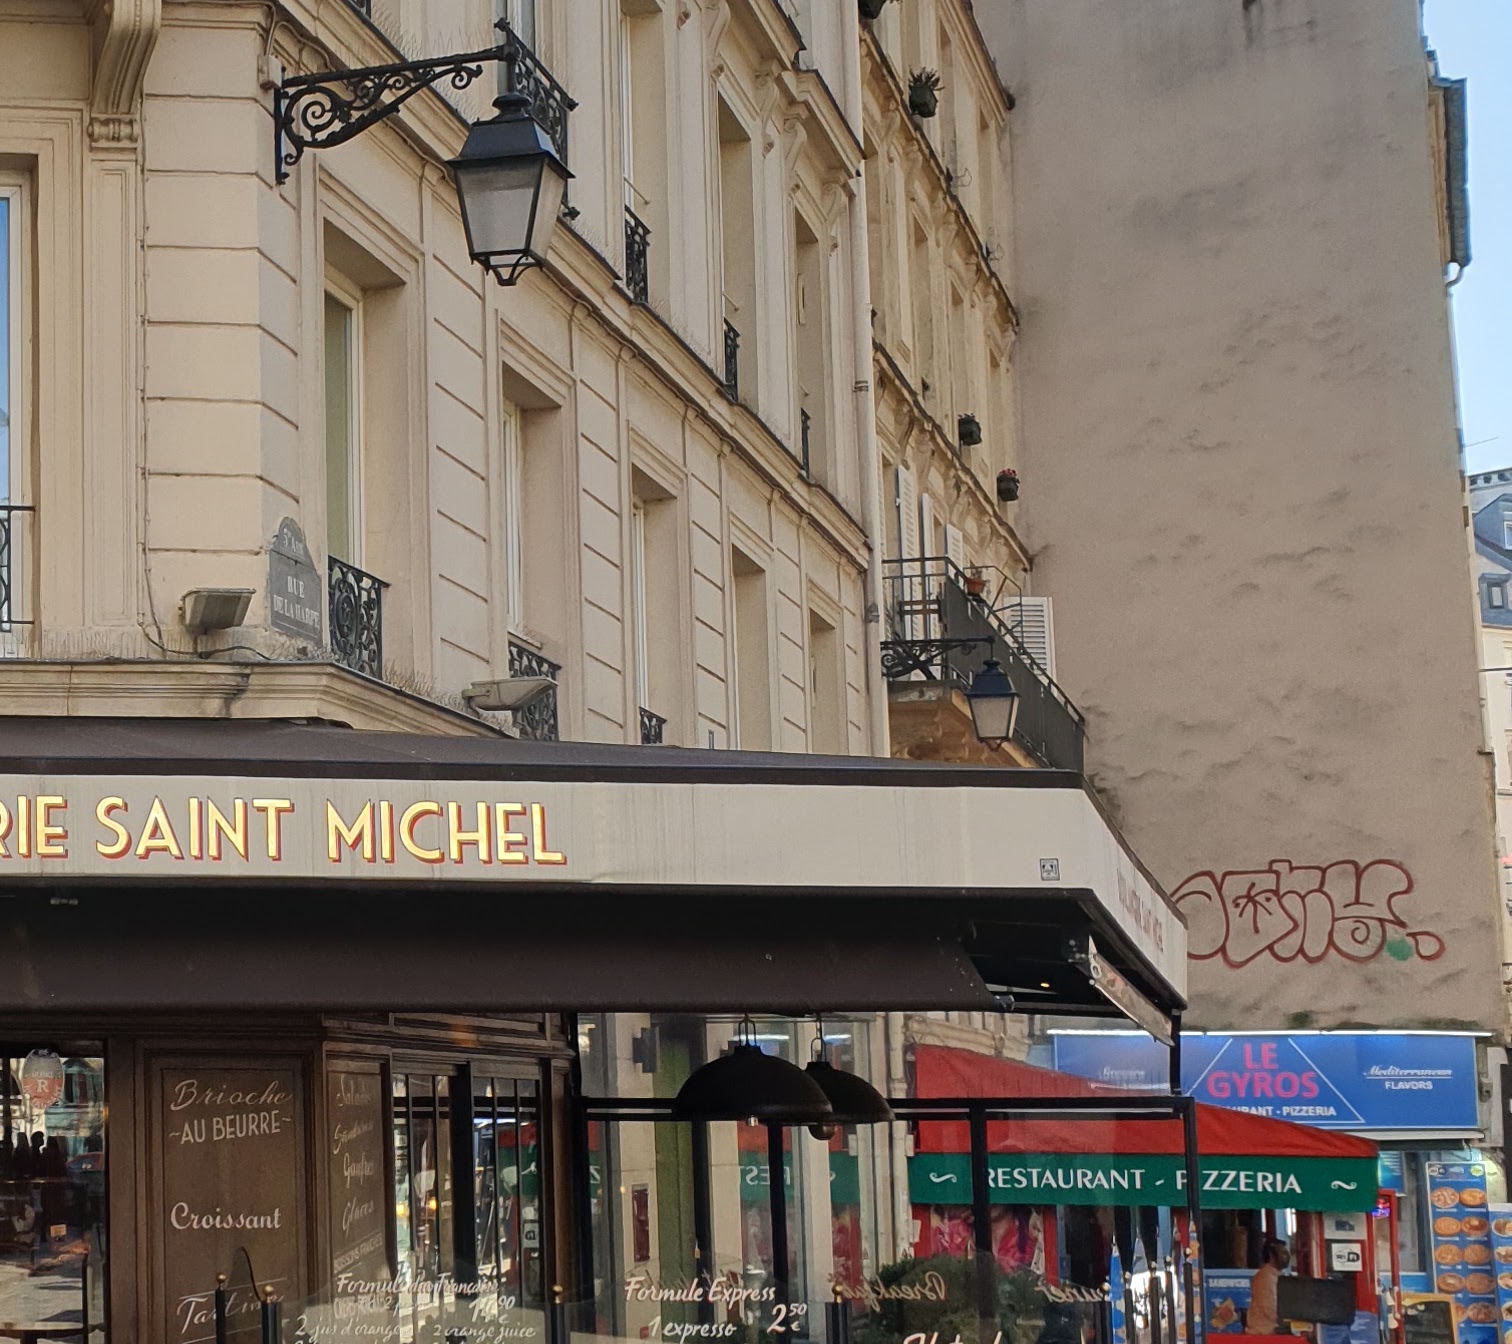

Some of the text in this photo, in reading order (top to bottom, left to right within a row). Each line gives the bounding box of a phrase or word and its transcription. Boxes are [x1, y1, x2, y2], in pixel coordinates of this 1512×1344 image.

[287, 576, 305, 599] RUE
[94, 794, 293, 862] SAINT
[325, 799, 567, 867] MICHEL
[1244, 1044, 1279, 1070] LE
[170, 1078, 293, 1112] Brioche
[1207, 1071, 1320, 1099] GYROS
[1384, 1081, 1434, 1090] FLAVORS
[1282, 1106, 1337, 1117] PIZZERIA
[180, 1110, 282, 1145] AU BEURRE
[988, 1167, 1303, 1194] RESTAURANT PZZERIA
[170, 1202, 282, 1231] Croissant
[624, 1275, 776, 1310] Formule Express
[295, 1316, 307, 1335] 2
[433, 1324, 442, 1337] 2
[444, 1326, 494, 1344] orange
[648, 1315, 662, 1338] 1
